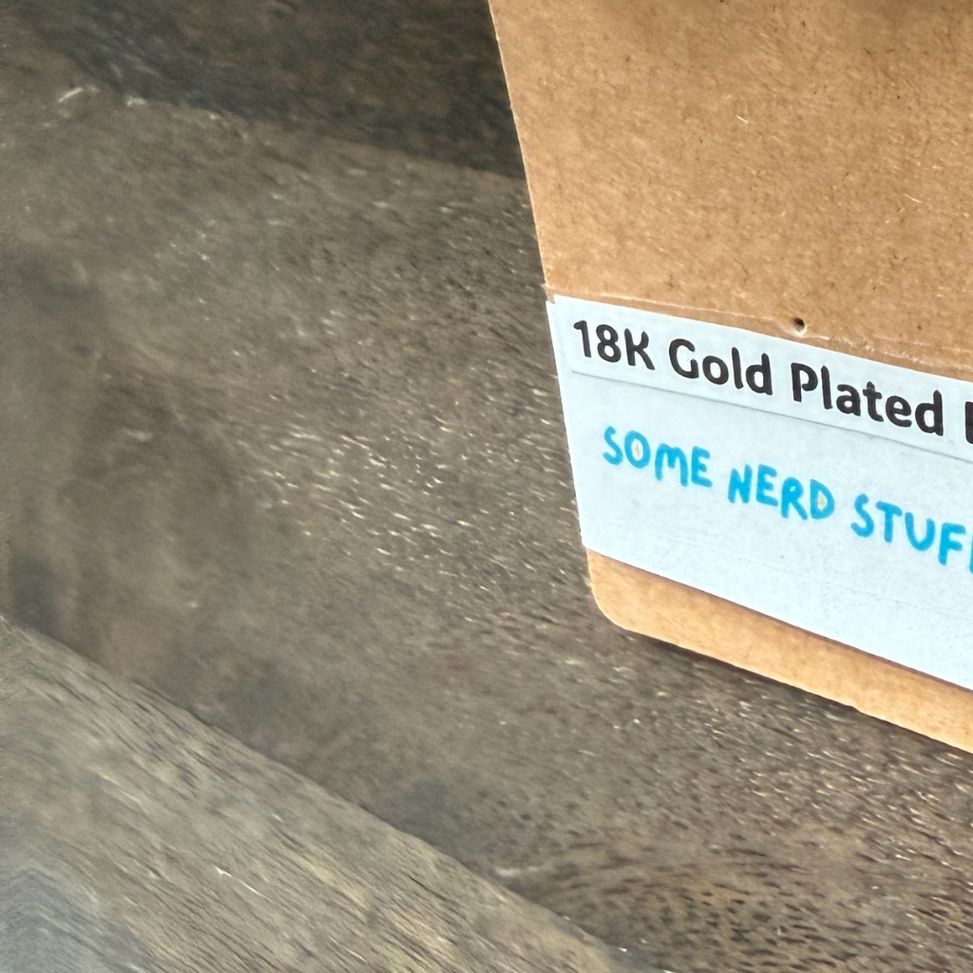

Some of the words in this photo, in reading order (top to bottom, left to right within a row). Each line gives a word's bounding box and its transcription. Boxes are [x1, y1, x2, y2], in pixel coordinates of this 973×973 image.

[572, 319, 656, 371] 18K
[667, 337, 773, 397] Gold
[790, 361, 944, 437] Plated
[601, 425, 713, 489] SOME
[726, 462, 836, 521] NERD
